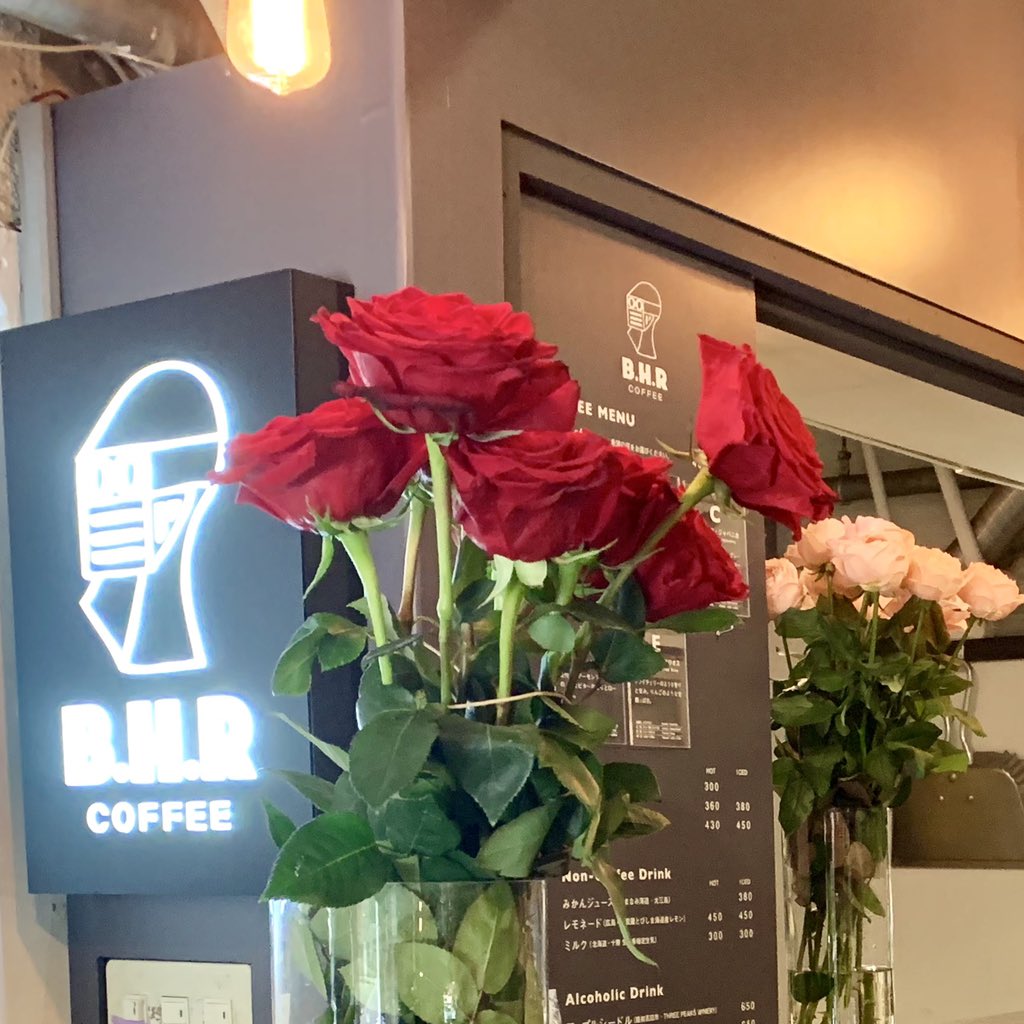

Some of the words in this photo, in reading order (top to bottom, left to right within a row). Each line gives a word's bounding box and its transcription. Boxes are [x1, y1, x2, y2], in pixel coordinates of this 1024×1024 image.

[621, 356, 669, 391] B.H.R
[627, 383, 663, 402] COFFEE
[598, 405, 635, 427] MENU
[61, 694, 258, 787] B.H.R
[704, 781, 720, 792] 300
[705, 801, 720, 811] 360
[735, 801, 751, 812] 380
[86, 800, 233, 834] COFFEE
[705, 820, 720, 830] 430
[736, 820, 751, 830] 450
[639, 867, 672, 880] Drink
[707, 911, 723, 922] 450
[738, 910, 753, 920] 450
[708, 930, 723, 941] 300
[739, 929, 754, 939] 300
[565, 988, 626, 1006] Alcoholic
[630, 984, 664, 999] Drink
[740, 1001, 755, 1011] 650
